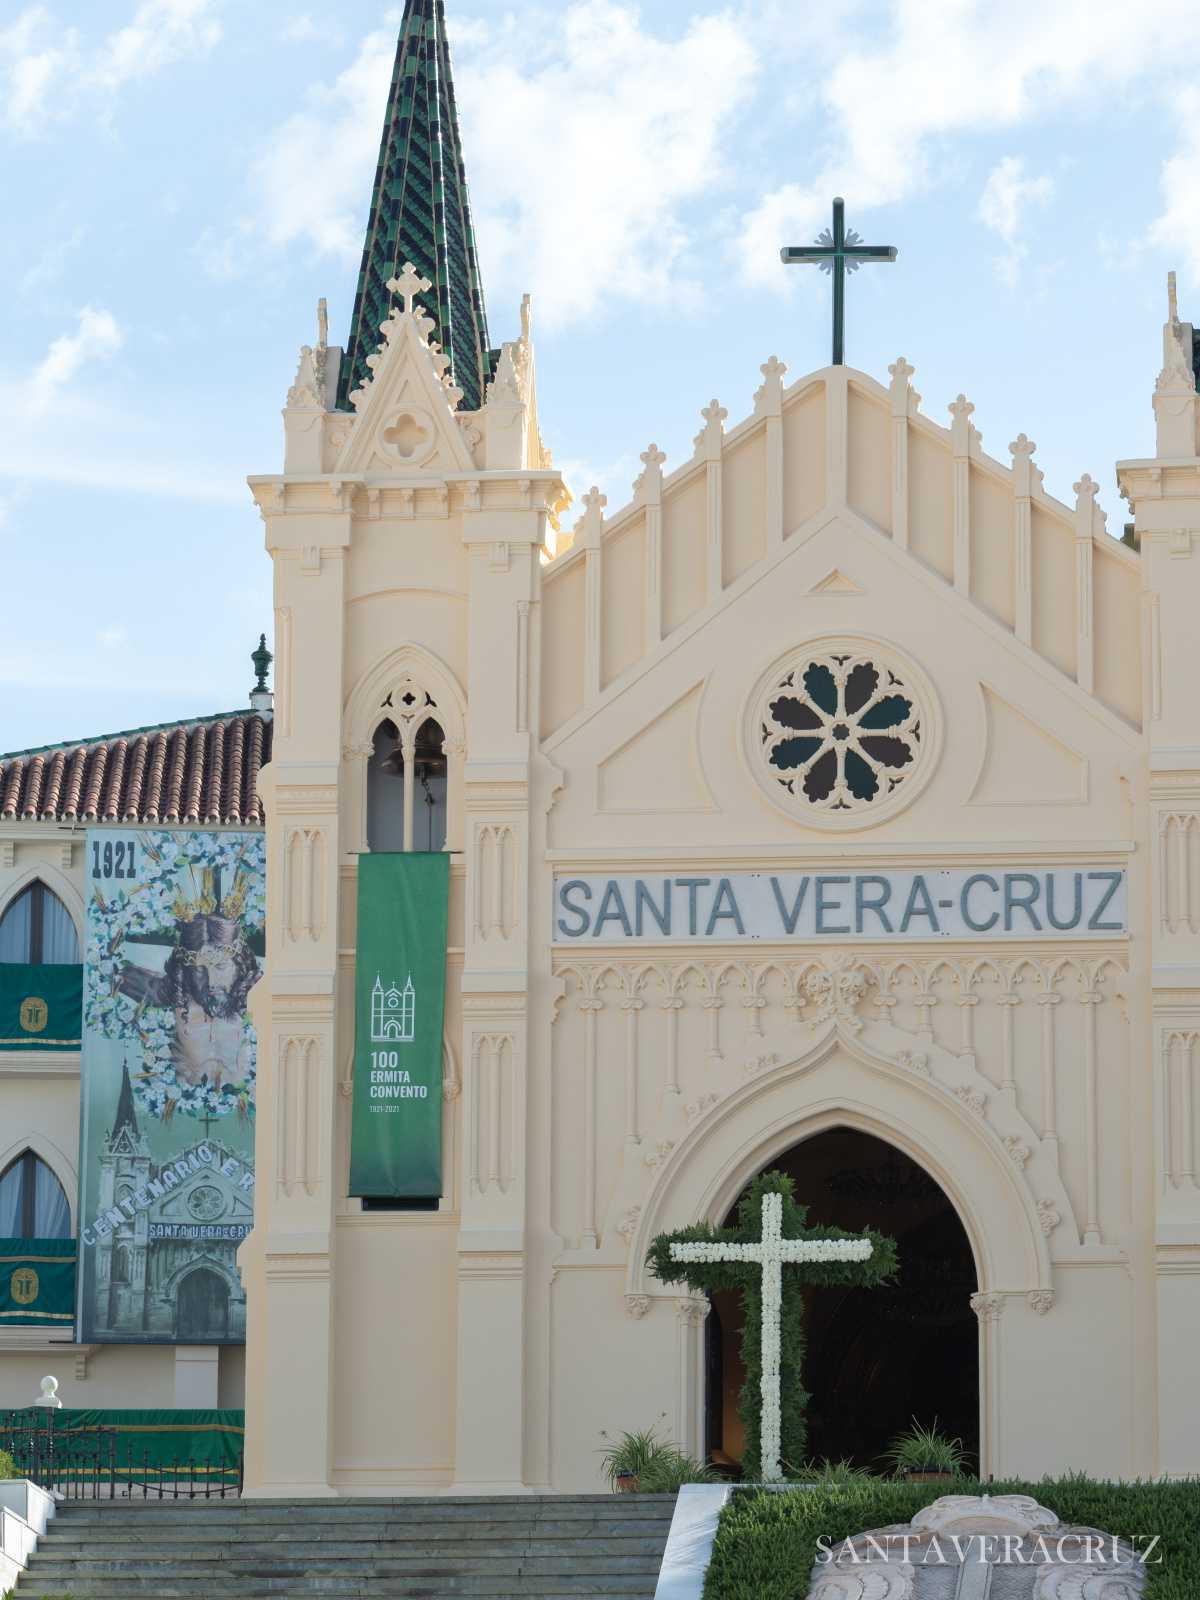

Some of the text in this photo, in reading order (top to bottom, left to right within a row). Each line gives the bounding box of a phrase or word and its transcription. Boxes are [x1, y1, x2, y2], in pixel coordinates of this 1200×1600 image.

[92, 841, 136, 879] 1921
[558, 871, 1123, 938] SANTA VERA-CRUZ
[370, 1051, 398, 1068] 100
[370, 1071, 410, 1083] ERMITA
[370, 1086, 427, 1098] CONVENTO
[81, 1145, 213, 1246] CENTENARIO
